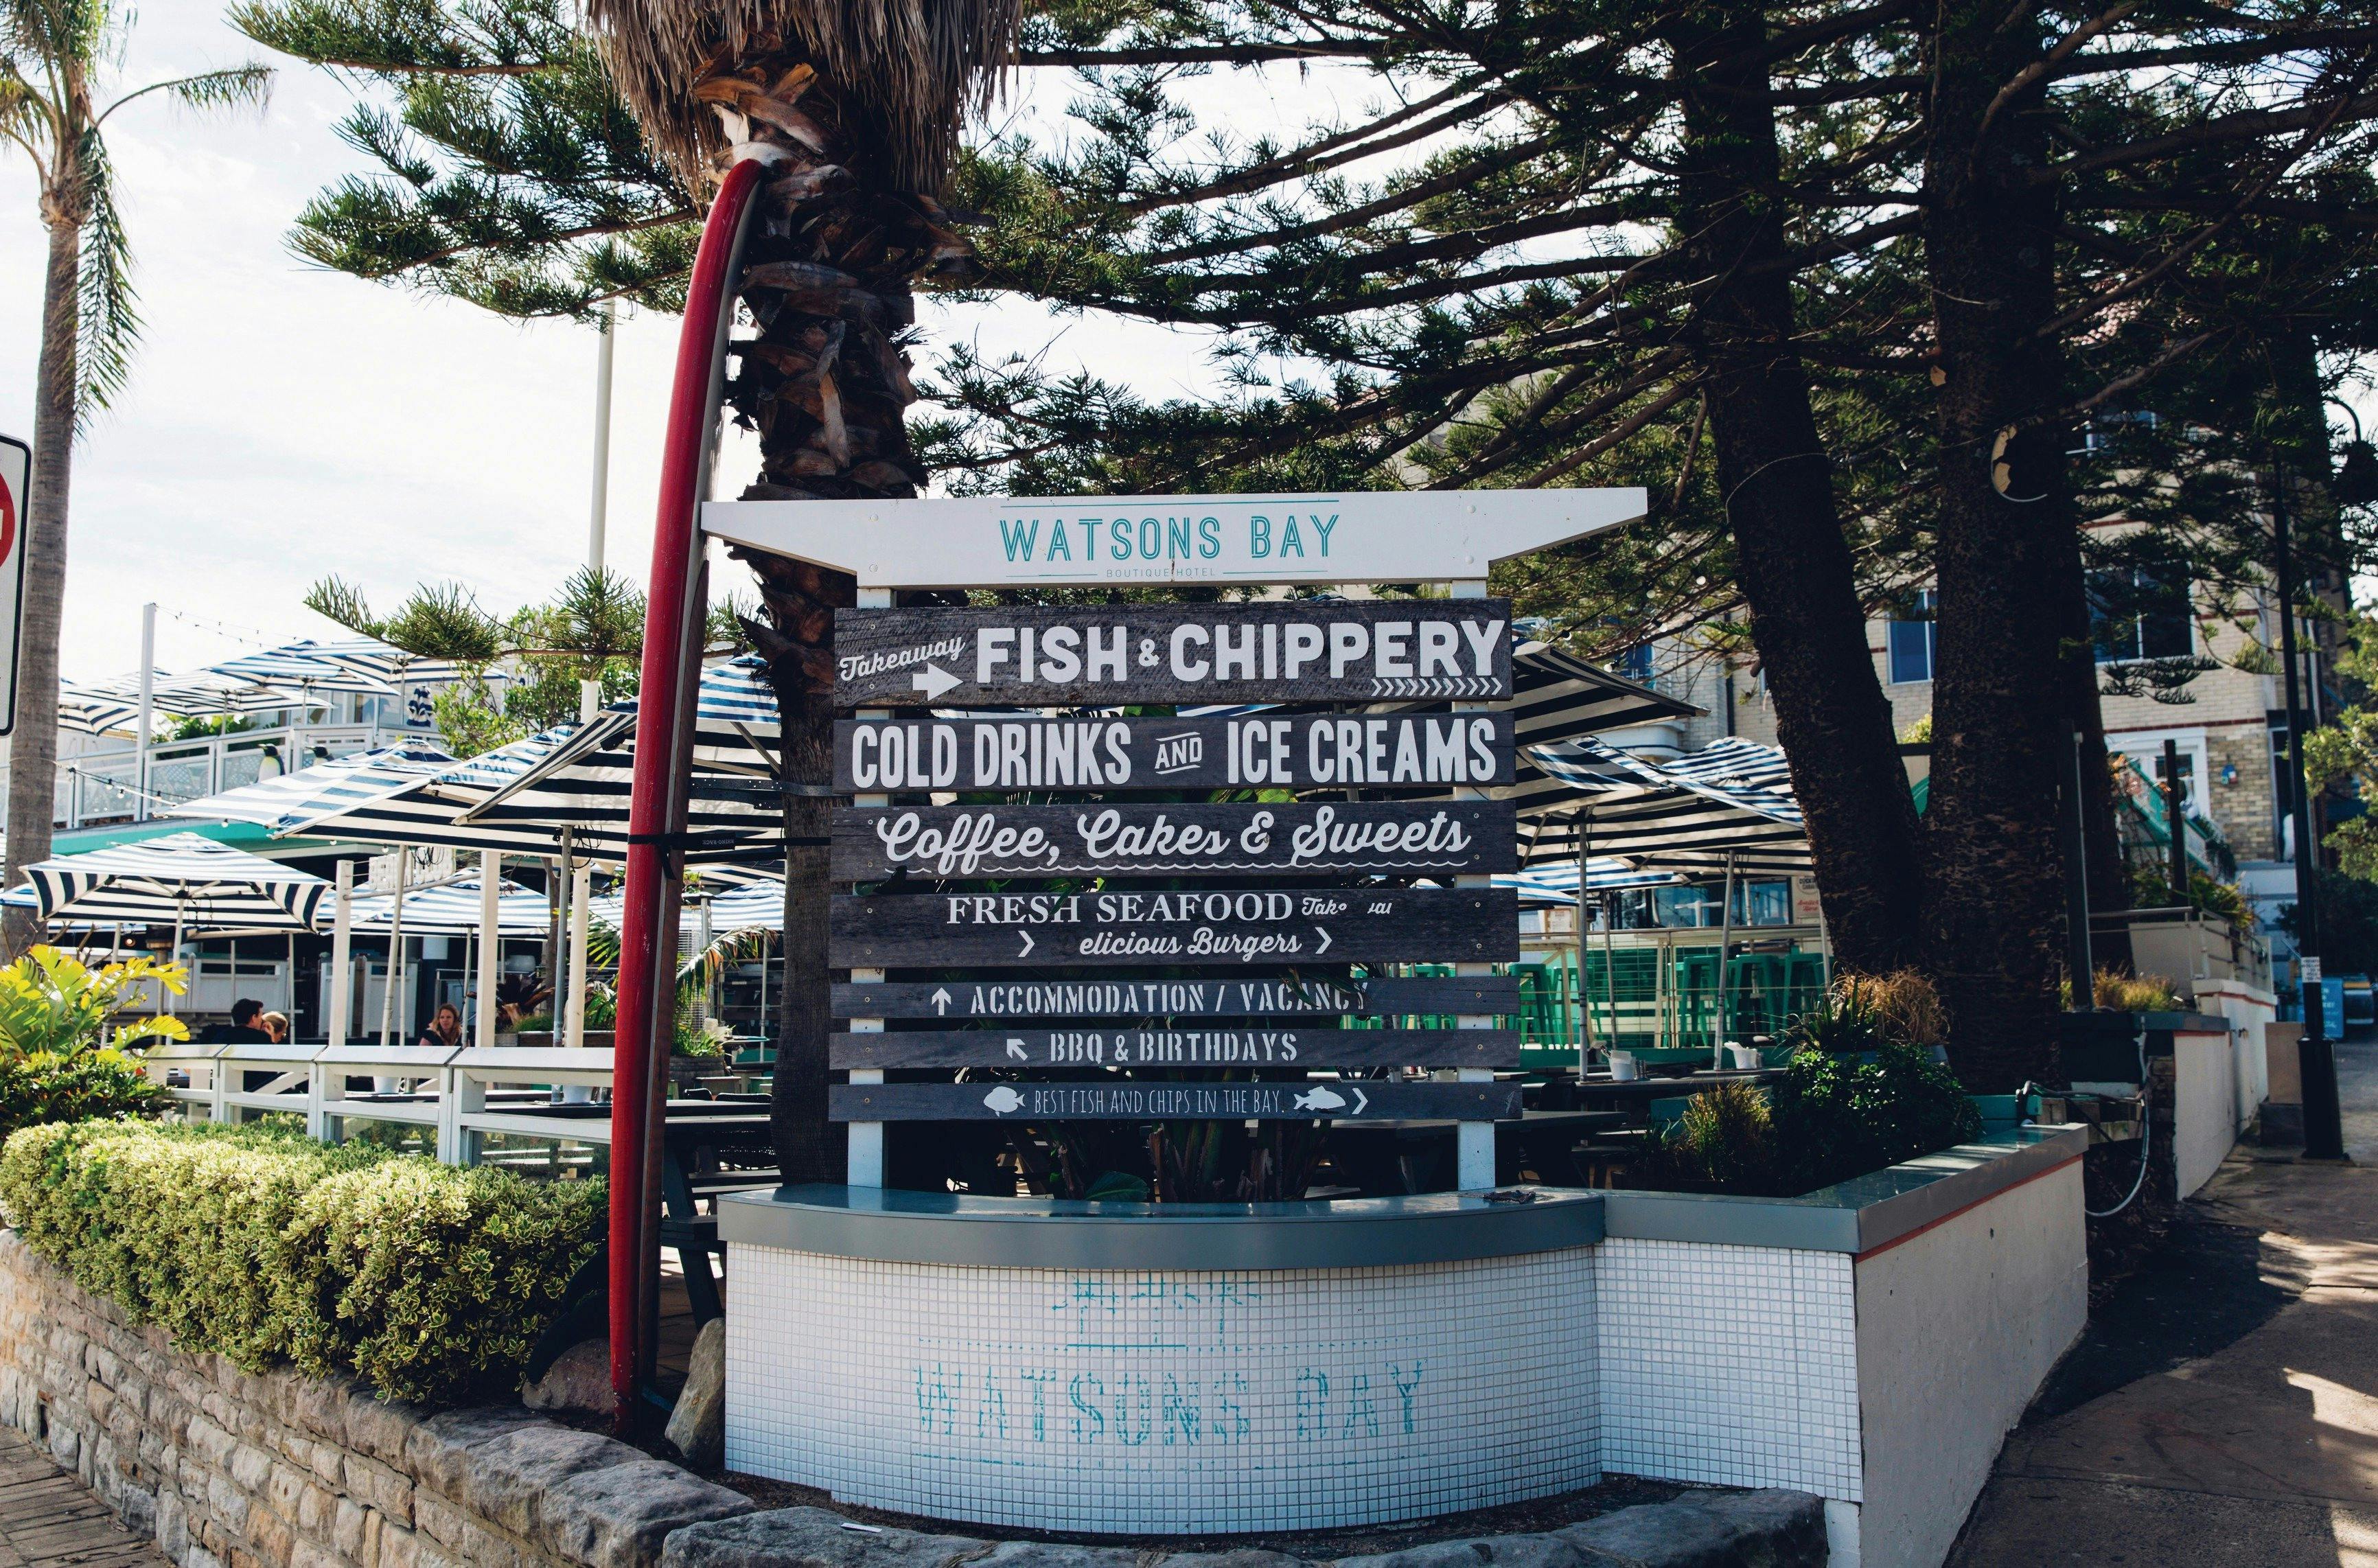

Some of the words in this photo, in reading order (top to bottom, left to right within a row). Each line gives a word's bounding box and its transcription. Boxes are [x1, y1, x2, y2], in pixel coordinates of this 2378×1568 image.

[1000, 516, 1222, 564] WATSONS
[1250, 513, 1341, 560] BAY
[1107, 568, 1169, 578] BOUTIQUE
[1177, 567, 1216, 577] HOTEL
[840, 636, 966, 682] Takeaway
[977, 625, 1127, 684] FISH
[1139, 638, 1161, 667] &
[1170, 620, 1504, 682] CHIPPERY
[853, 724, 958, 788] COLD
[974, 723, 1132, 786] DRINKS
[1155, 738, 1203, 768] AND
[1228, 721, 1293, 784] ICE
[1309, 718, 1497, 783] CREAMS
[877, 811, 1060, 875] Coffee,
[1078, 810, 1230, 857] Cakes
[1240, 811, 1273, 854] &
[1291, 805, 1472, 861] Sweets
[947, 896, 1081, 923] FRESH
[1096, 892, 1293, 923] SEAFOOD
[1188, 927, 1303, 962] Burgers
[971, 984, 1205, 1014] ACCOMMODATION
[1050, 1033, 1103, 1064] BBQ
[1115, 1035, 1129, 1062] &
[1140, 1033, 1298, 1062] BIRTHDAYS
[1035, 1090, 1065, 1114] BEST
[1072, 1090, 1104, 1114] FISH
[1110, 1090, 1142, 1114] AND
[1149, 1090, 1190, 1114] CHIPS
[1197, 1090, 1216, 1114] IN
[1223, 1090, 1247, 1114] THE
